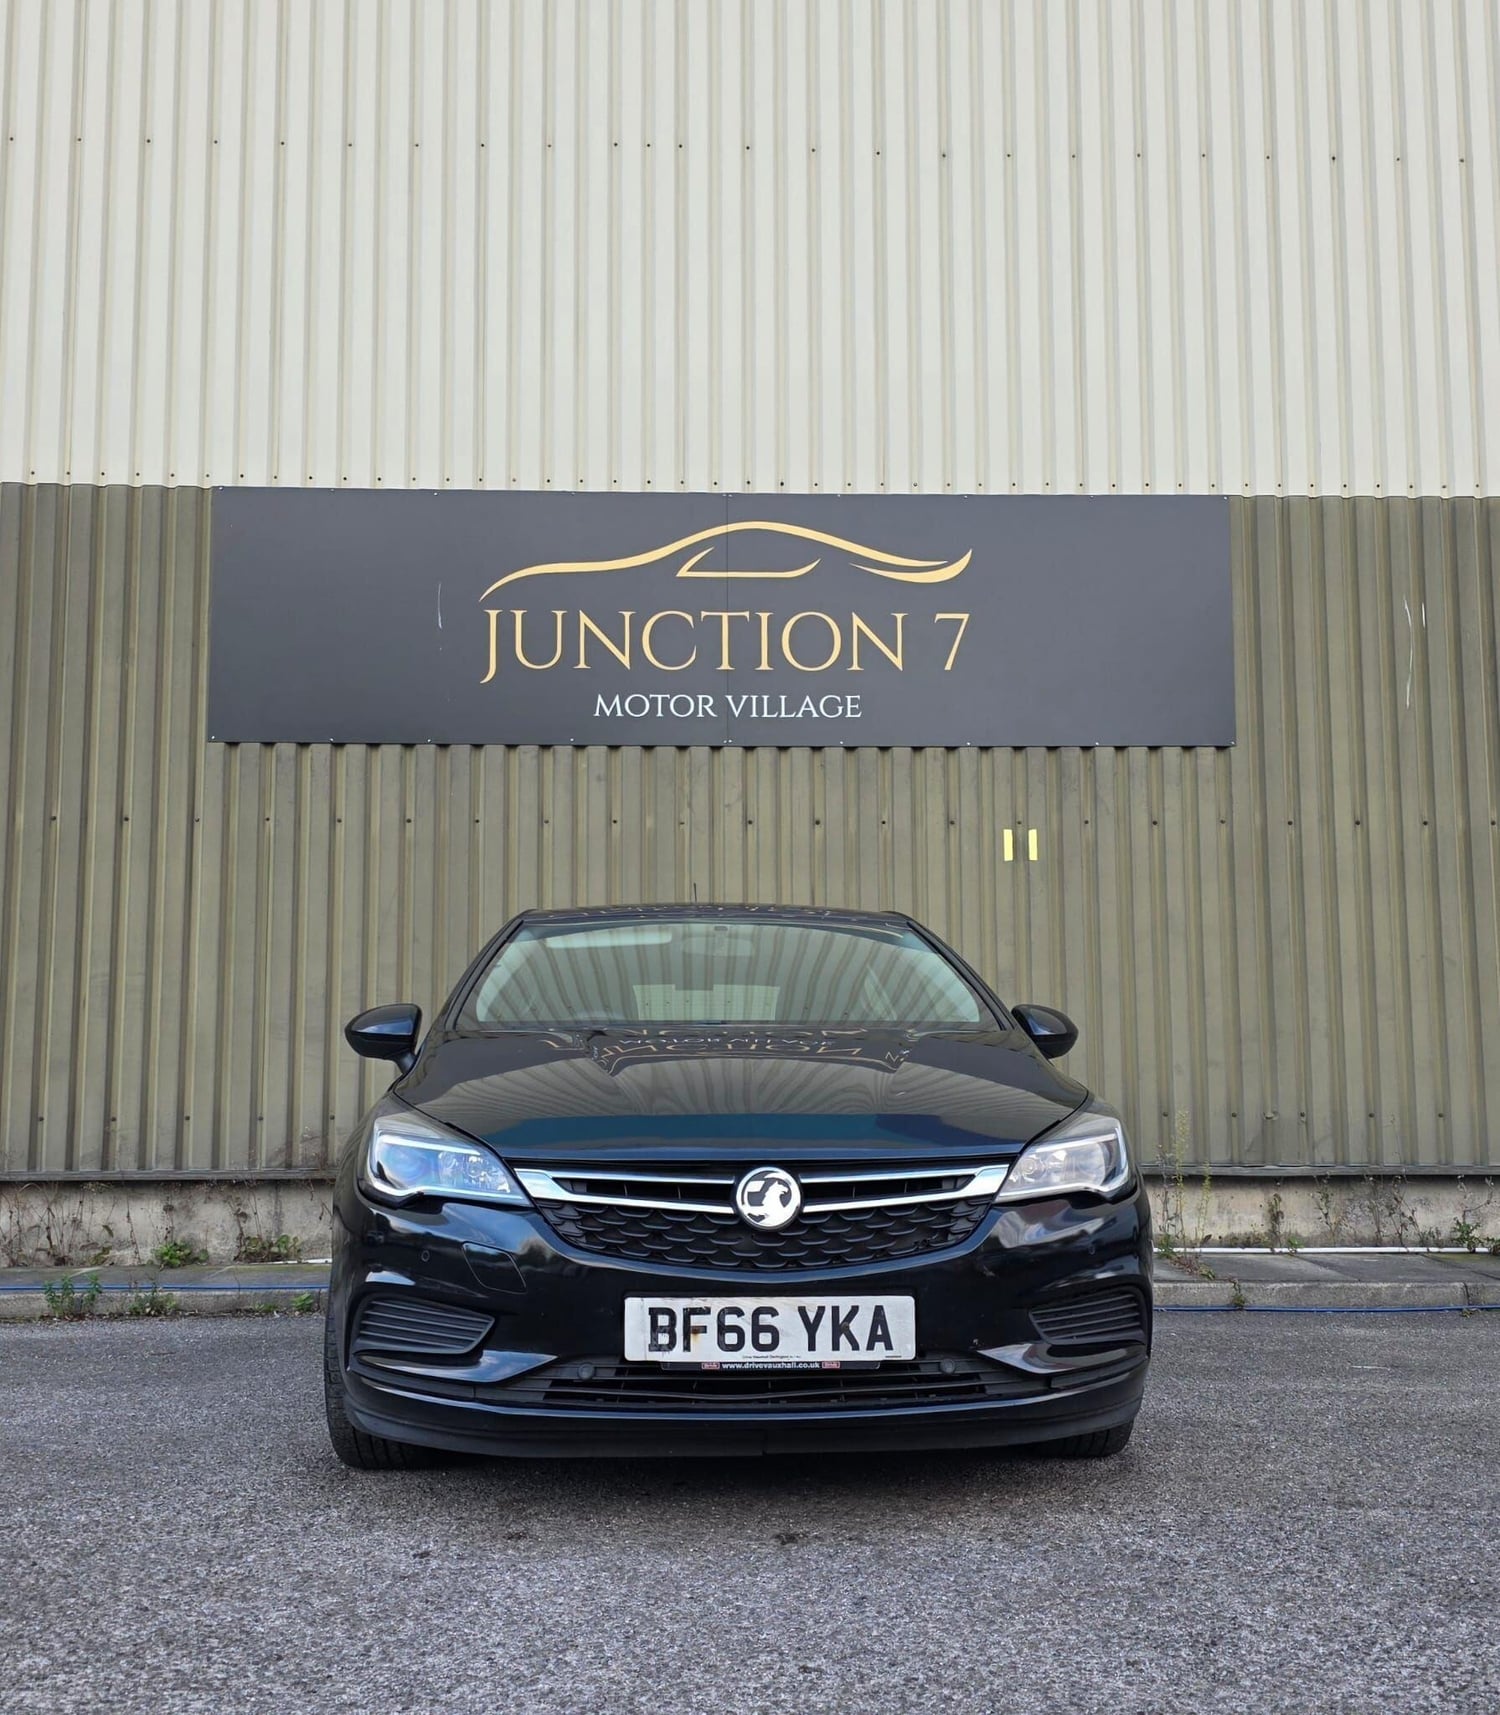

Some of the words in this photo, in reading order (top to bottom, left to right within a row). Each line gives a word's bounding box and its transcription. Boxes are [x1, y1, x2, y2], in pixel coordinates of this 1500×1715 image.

[480, 609, 908, 685] JUNCTION
[934, 612, 970, 671] 7
[594, 693, 719, 718] MOTOR
[726, 693, 863, 719] VILLAGE
[648, 1306, 780, 1352] BF66
[798, 1305, 894, 1351] YKA
[721, 1361, 820, 1369] www.drivevauxhall.co.uk
